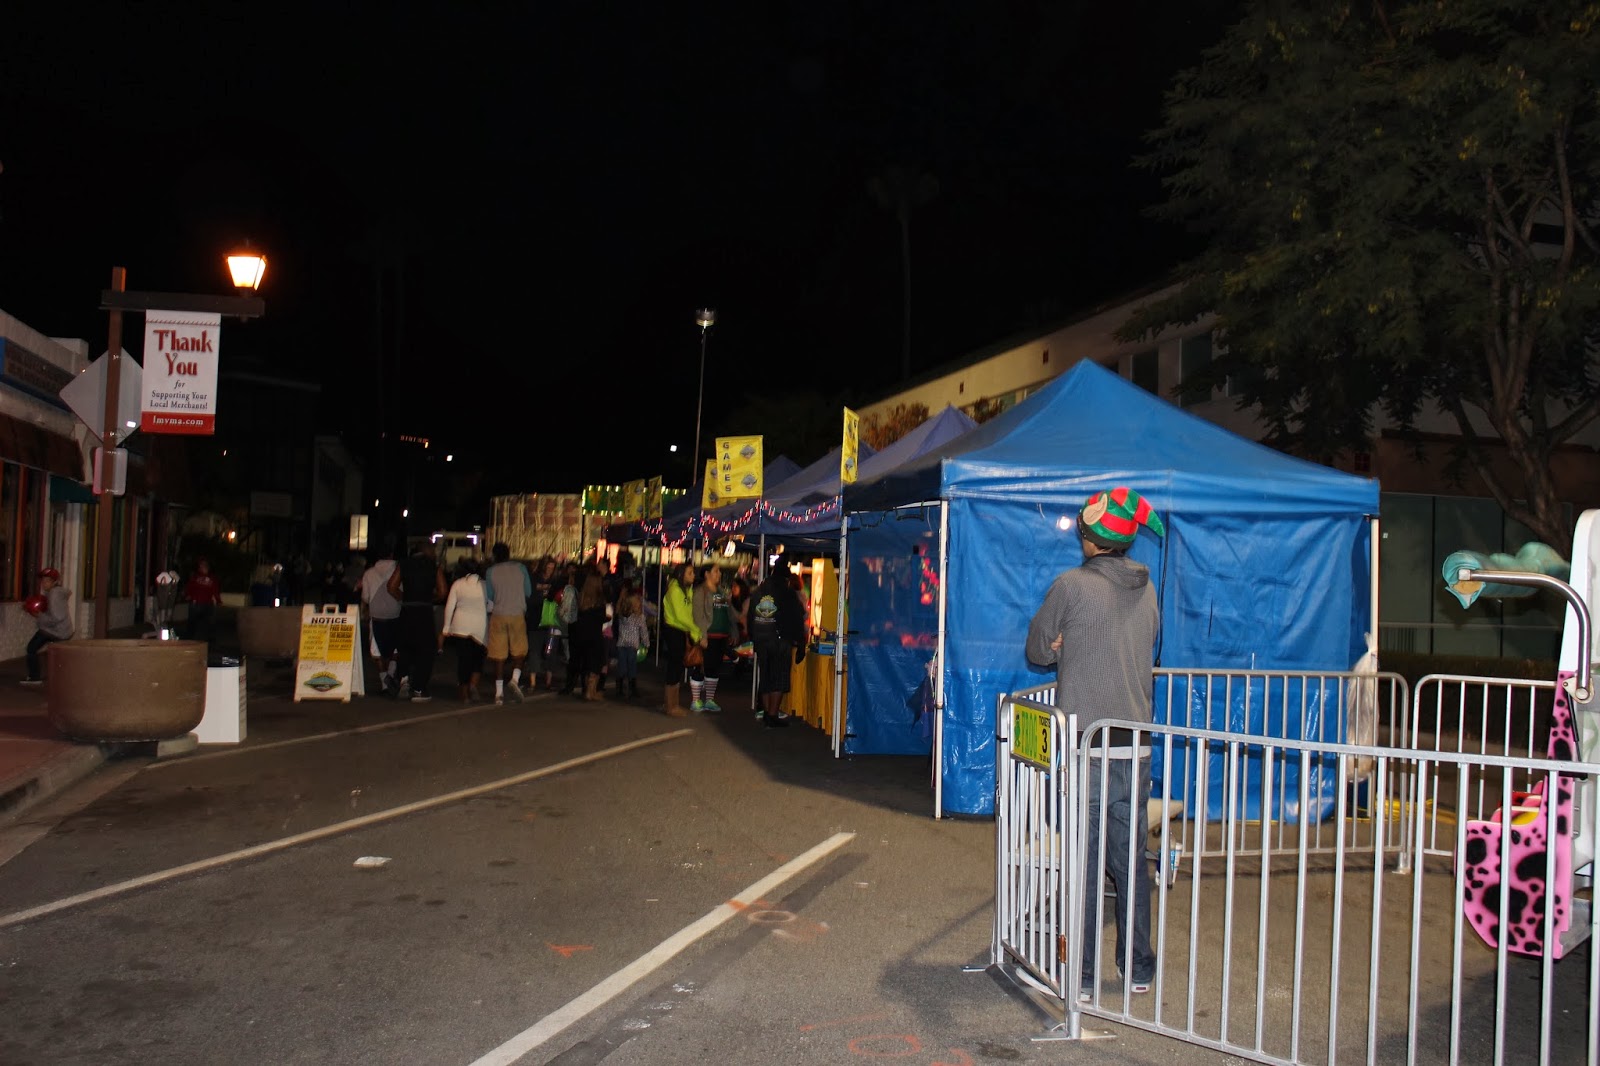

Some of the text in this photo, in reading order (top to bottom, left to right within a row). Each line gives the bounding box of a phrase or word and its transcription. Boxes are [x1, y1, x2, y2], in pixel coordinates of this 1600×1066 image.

[153, 330, 213, 353] Thank
[165, 353, 198, 376] You
[174, 380, 186, 389] for
[152, 390, 208, 401] Supporting Your
[150, 400, 208, 410] Local Merchants!
[153, 415, 204, 426] lmvma.com
[722, 441, 732, 492] GAMES
[1042, 728, 1048, 754] 3
